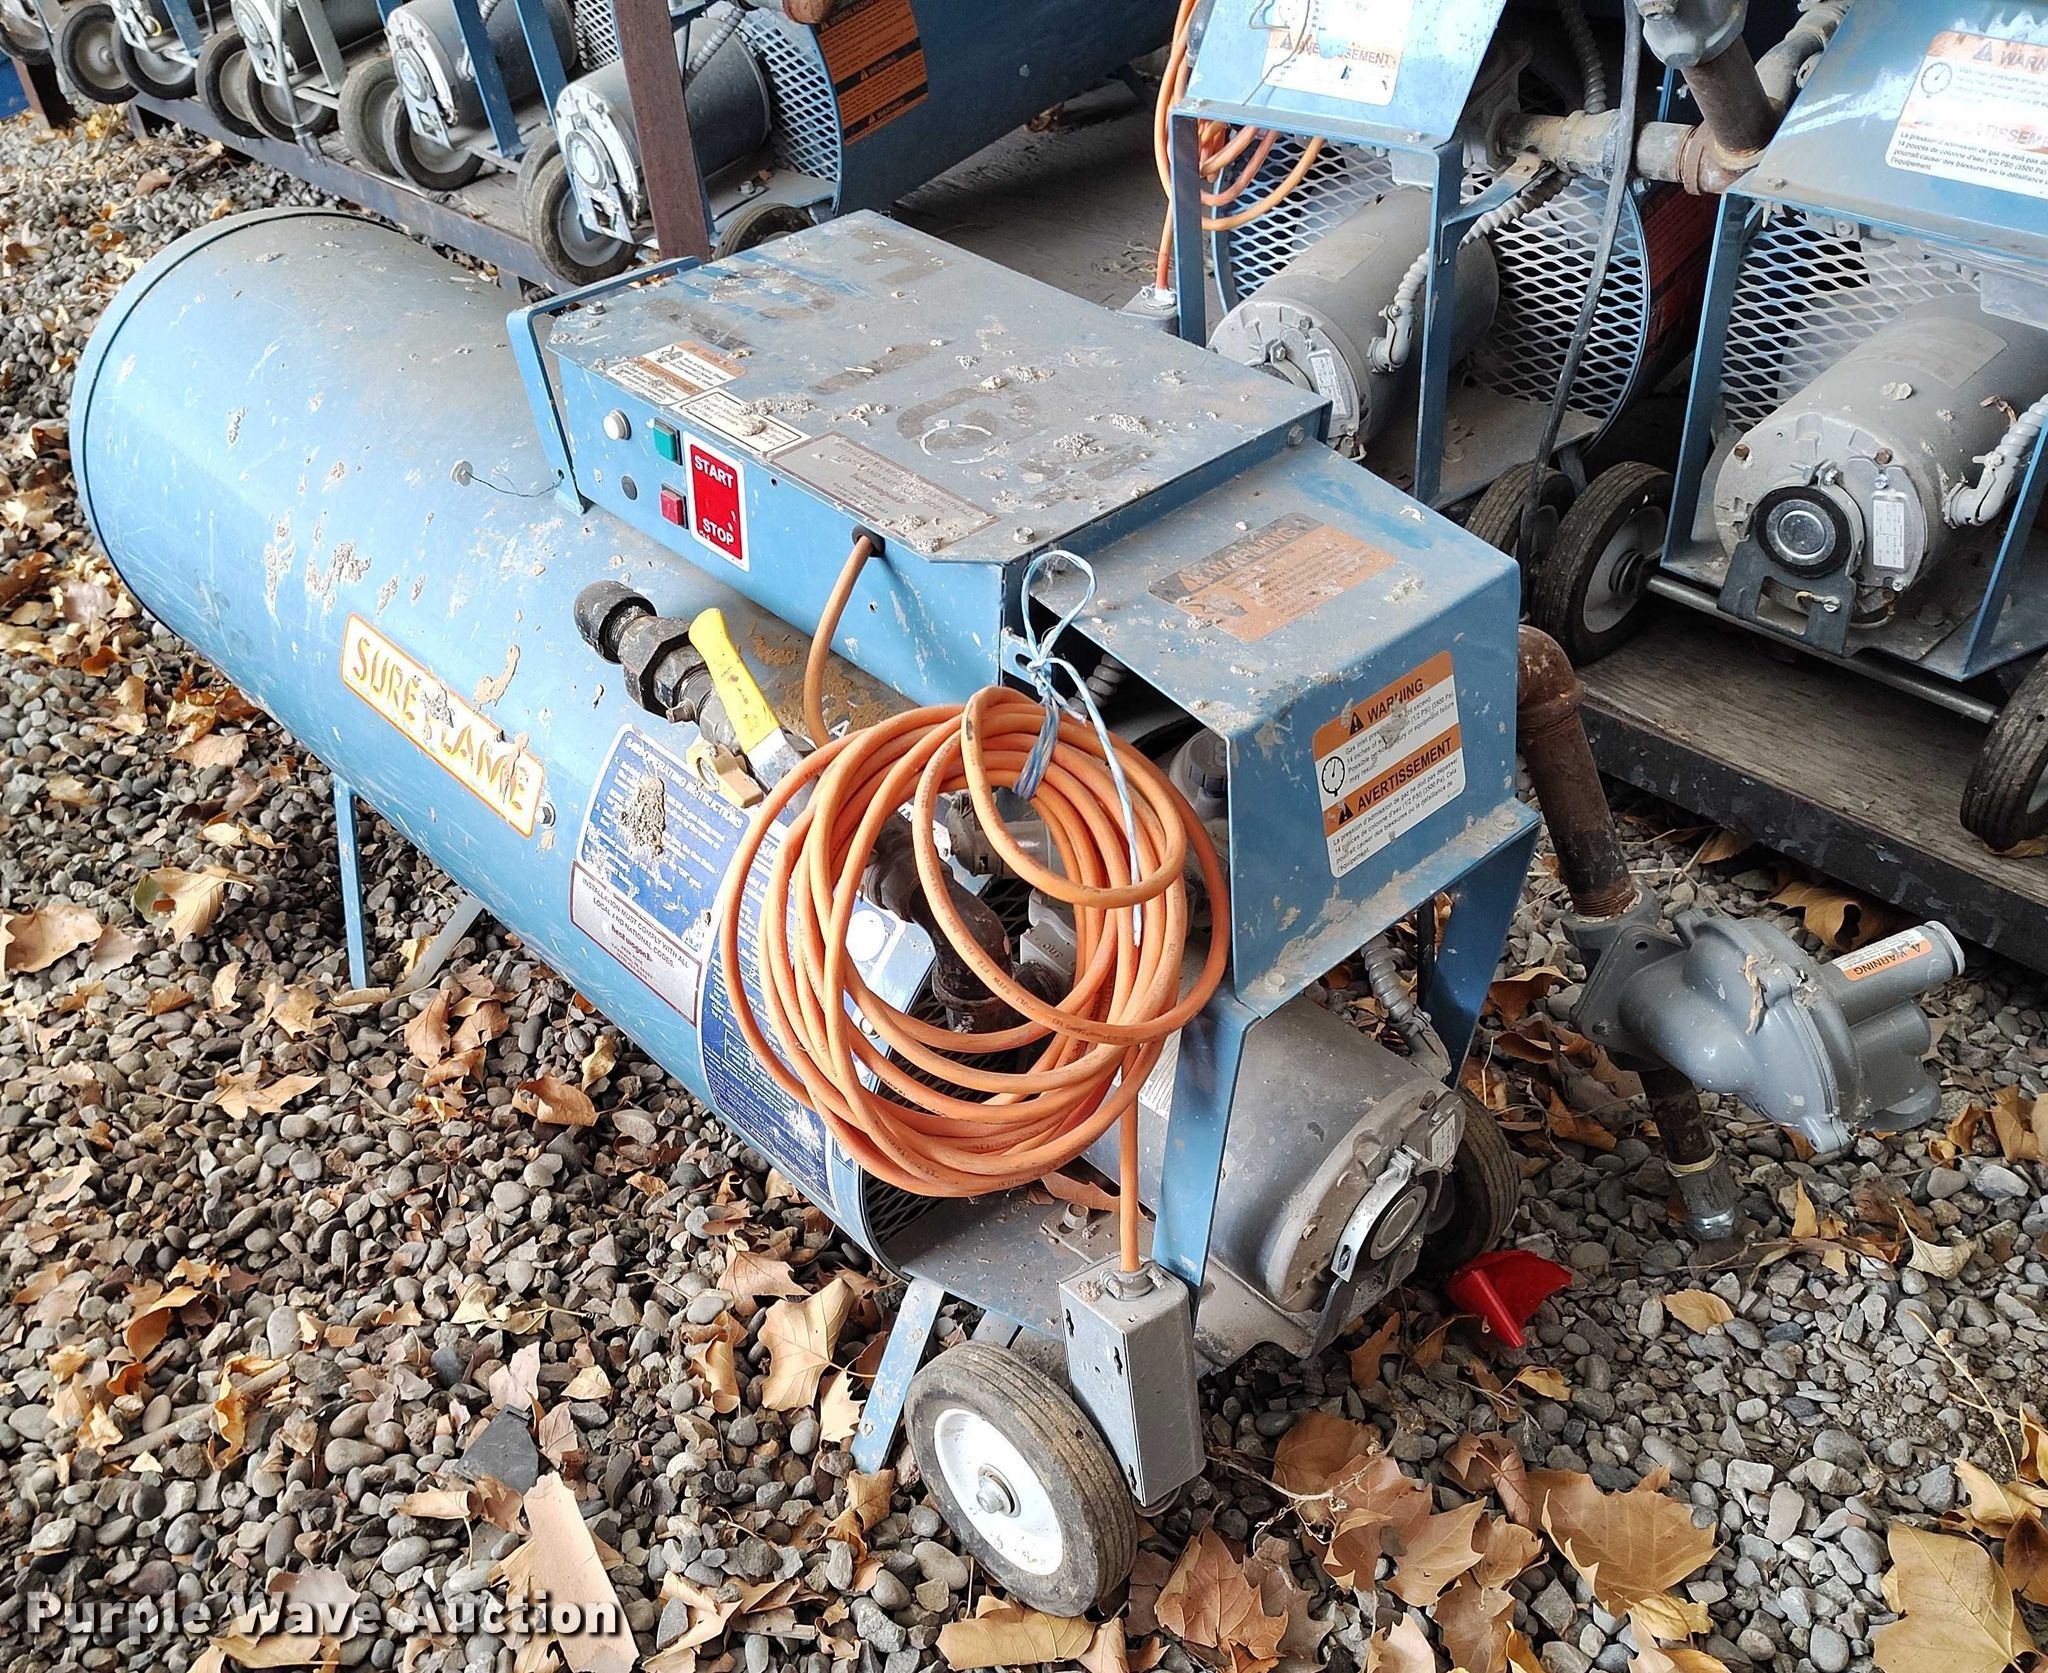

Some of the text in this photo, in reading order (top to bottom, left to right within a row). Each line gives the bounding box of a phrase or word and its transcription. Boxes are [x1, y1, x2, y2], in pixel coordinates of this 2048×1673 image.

[693, 454, 735, 488] START
[702, 517, 736, 547] STOP
[354, 638, 420, 720] SURE
[1367, 676, 1423, 724] WARNING
[1345, 743, 1355, 755] Gas
[1346, 755, 1353, 765] 14
[1354, 743, 1371, 760] inches
[1371, 739, 1377, 749] of
[1347, 754, 1369, 774] Possible
[1356, 736, 1452, 811] AVERTISSEMENT
[1349, 772, 1360, 784] may
[684, 779, 744, 830] INSTRUCTIONS
[1333, 835, 1340, 846] La
[1340, 820, 1362, 841] pression
[1362, 800, 1392, 825] d'admission
[1393, 795, 1399, 804] de
[1400, 789, 1409, 801] gaz
[1416, 777, 1426, 788] doit
[1427, 771, 1435, 783] pas
[1334, 845, 1341, 854] 14
[1360, 827, 1367, 837] de
[1367, 813, 1387, 832] colonne
[1446, 766, 1457, 778] Cela
[1356, 832, 1373, 849] causer
[1373, 825, 1382, 837] des
[1446, 778, 1452, 787] de
[593, 896, 610, 916] LOCAL
[624, 921, 652, 950] NATIONAL
[621, 908, 636, 926] MUST
[637, 921, 661, 947] COMPLY
[662, 941, 677, 960] WITH
[677, 954, 689, 969] ALL
